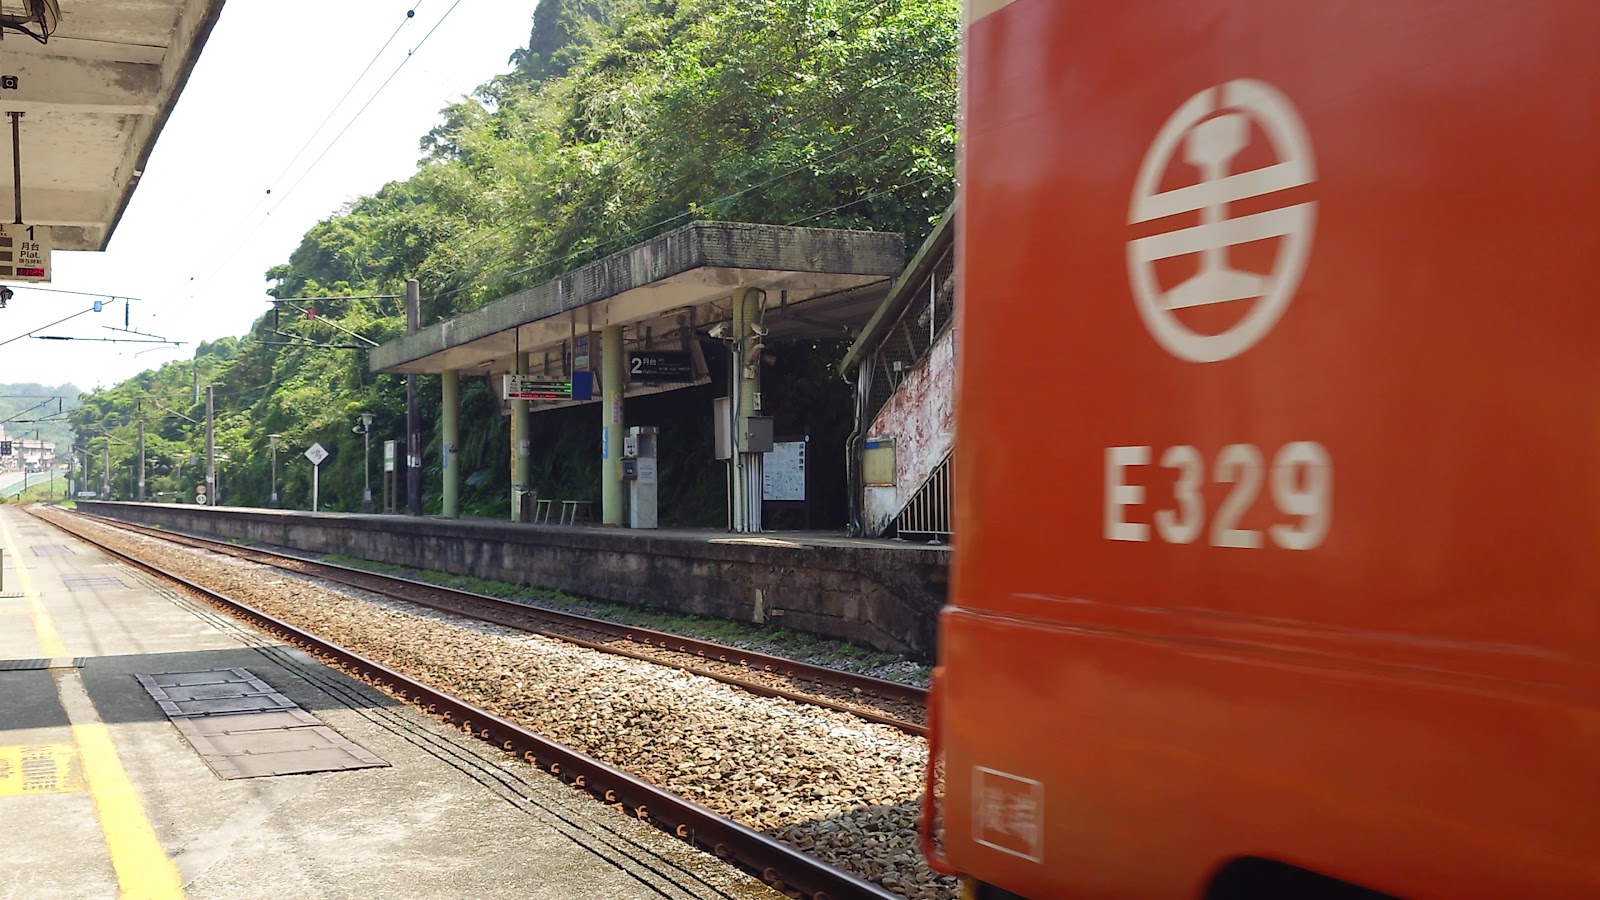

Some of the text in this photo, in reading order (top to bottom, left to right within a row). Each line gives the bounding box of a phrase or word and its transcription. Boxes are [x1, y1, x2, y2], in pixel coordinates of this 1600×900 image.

[25, 225, 34, 241] 1
[21, 242, 40, 251] 月台
[20, 250, 41, 259] Plat.
[630, 357, 643, 374] 2
[642, 357, 657, 366] 月台
[511, 375, 517, 383] 2
[1103, 440, 1334, 551] E329
